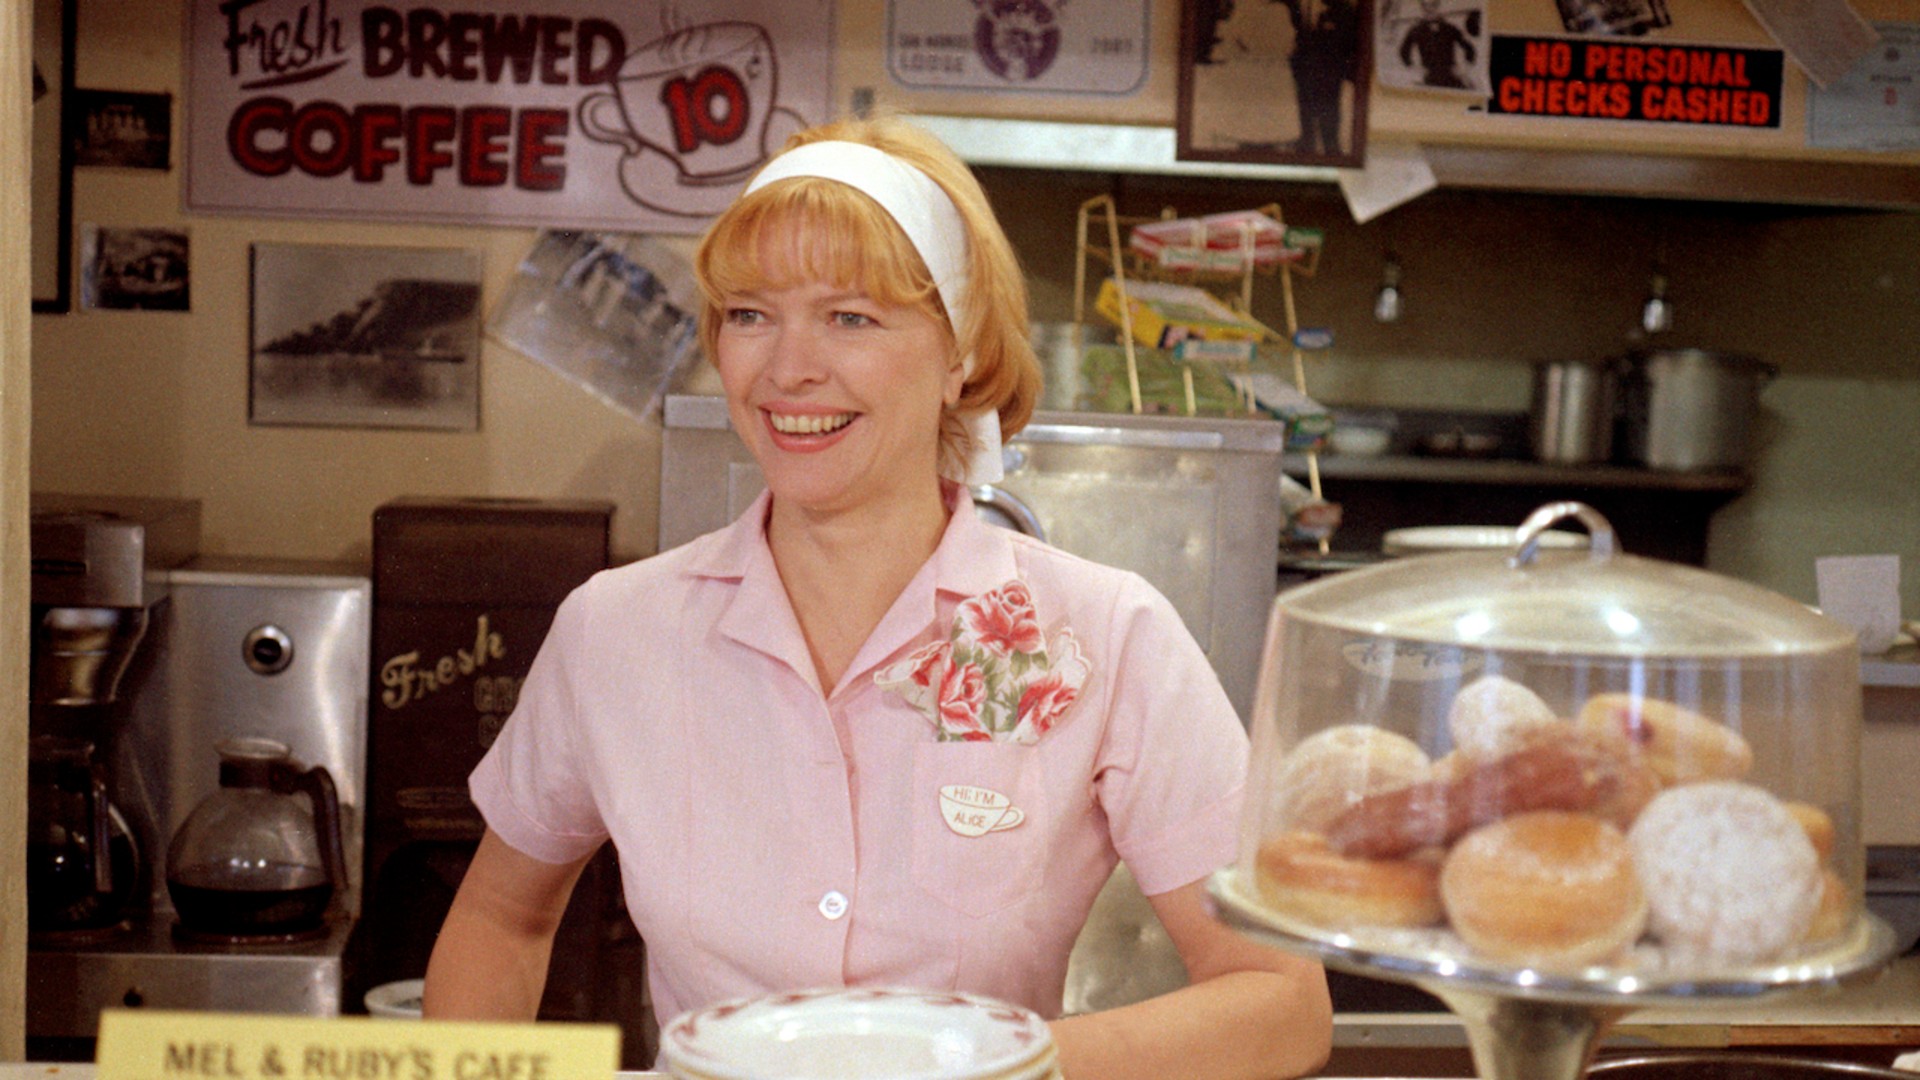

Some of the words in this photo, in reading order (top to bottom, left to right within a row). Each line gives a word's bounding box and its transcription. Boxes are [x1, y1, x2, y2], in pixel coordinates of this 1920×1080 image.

[223, 0, 343, 76] Fresh
[361, 7, 625, 86] BREWED
[1524, 41, 1572, 78] NO
[1585, 44, 1751, 87] PERSONAL
[1500, 75, 1631, 118] CHECKS
[1641, 85, 1770, 125] CASHED
[227, 97, 569, 190] COFFEE
[381, 614, 507, 710] Fresh
[953, 811, 986, 828] ALICE
[165, 1042, 242, 1076] MEL
[259, 1046, 287, 1076] &
[301, 1046, 433, 1080] RUBY'S
[453, 1050, 552, 1080] CAFE
